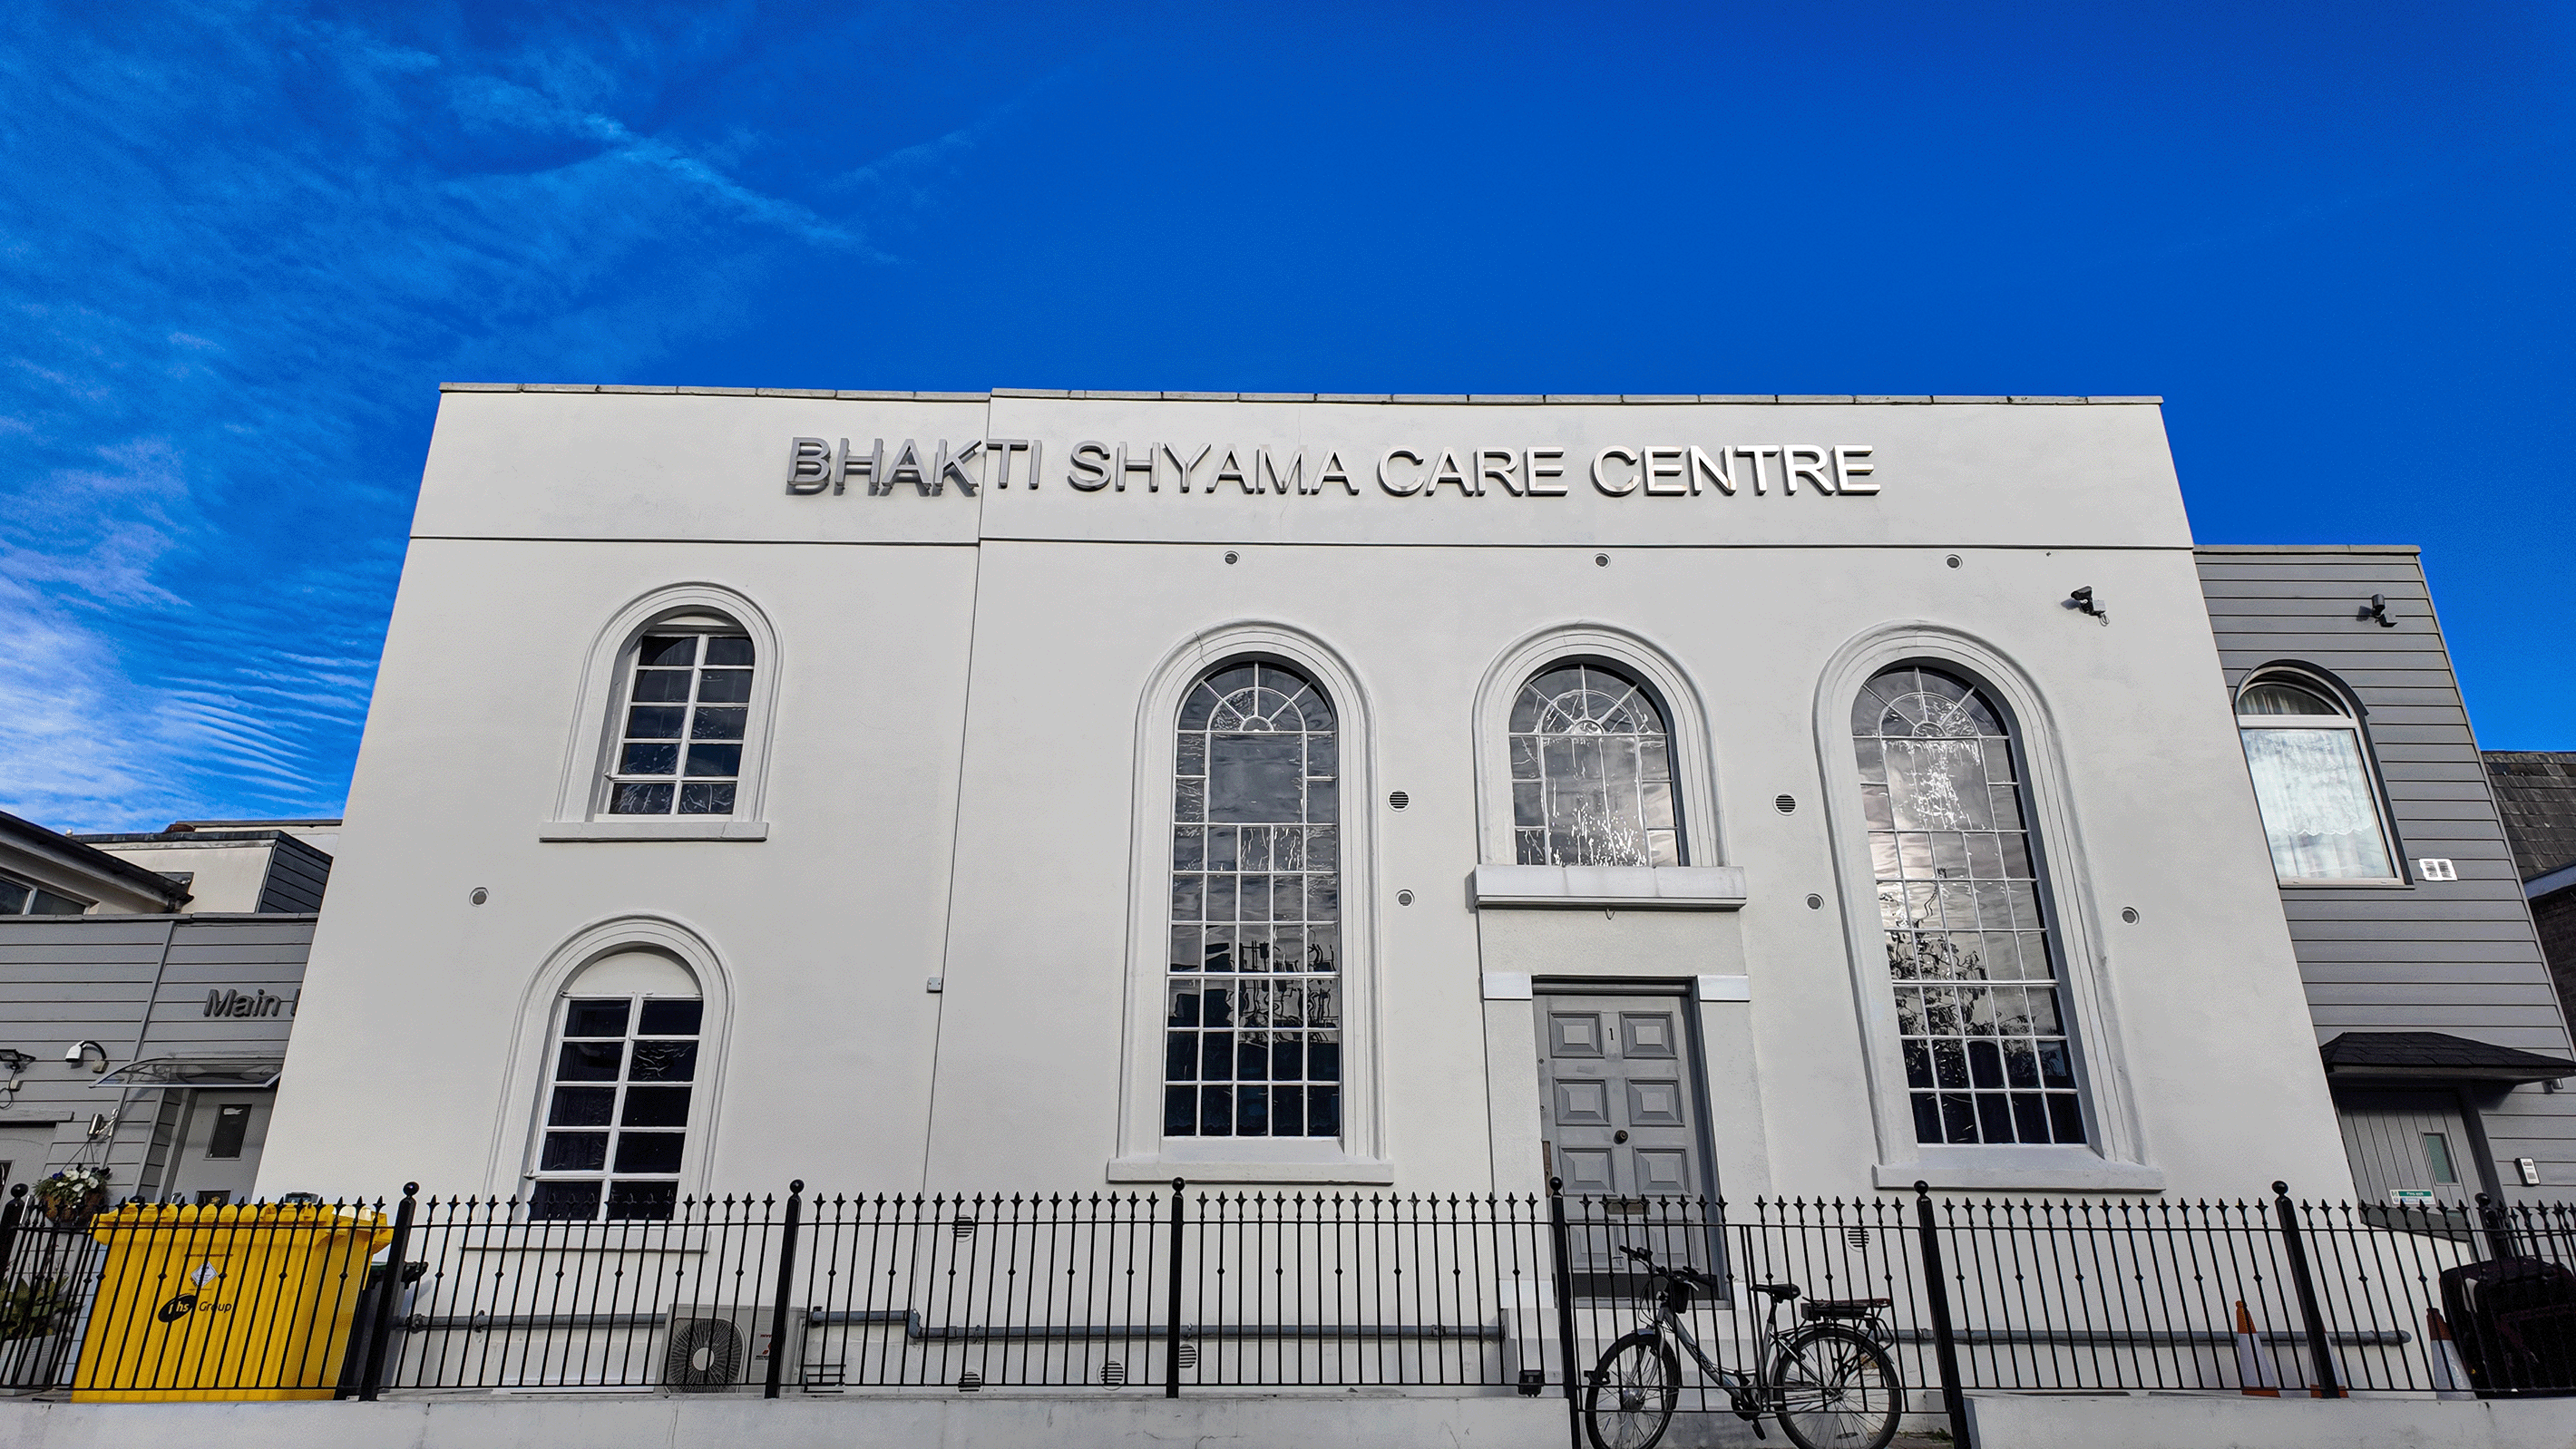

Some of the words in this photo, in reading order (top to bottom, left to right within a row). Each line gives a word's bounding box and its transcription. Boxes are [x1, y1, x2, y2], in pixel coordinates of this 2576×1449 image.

[785, 436, 1042, 491] BHAKTI
[1067, 440, 1360, 495] SHYAMA
[1378, 445, 1568, 497] CARE
[1592, 444, 1881, 497] CENTRE
[203, 988, 281, 1017] Main
[1608, 1027, 1615, 1041] 1
